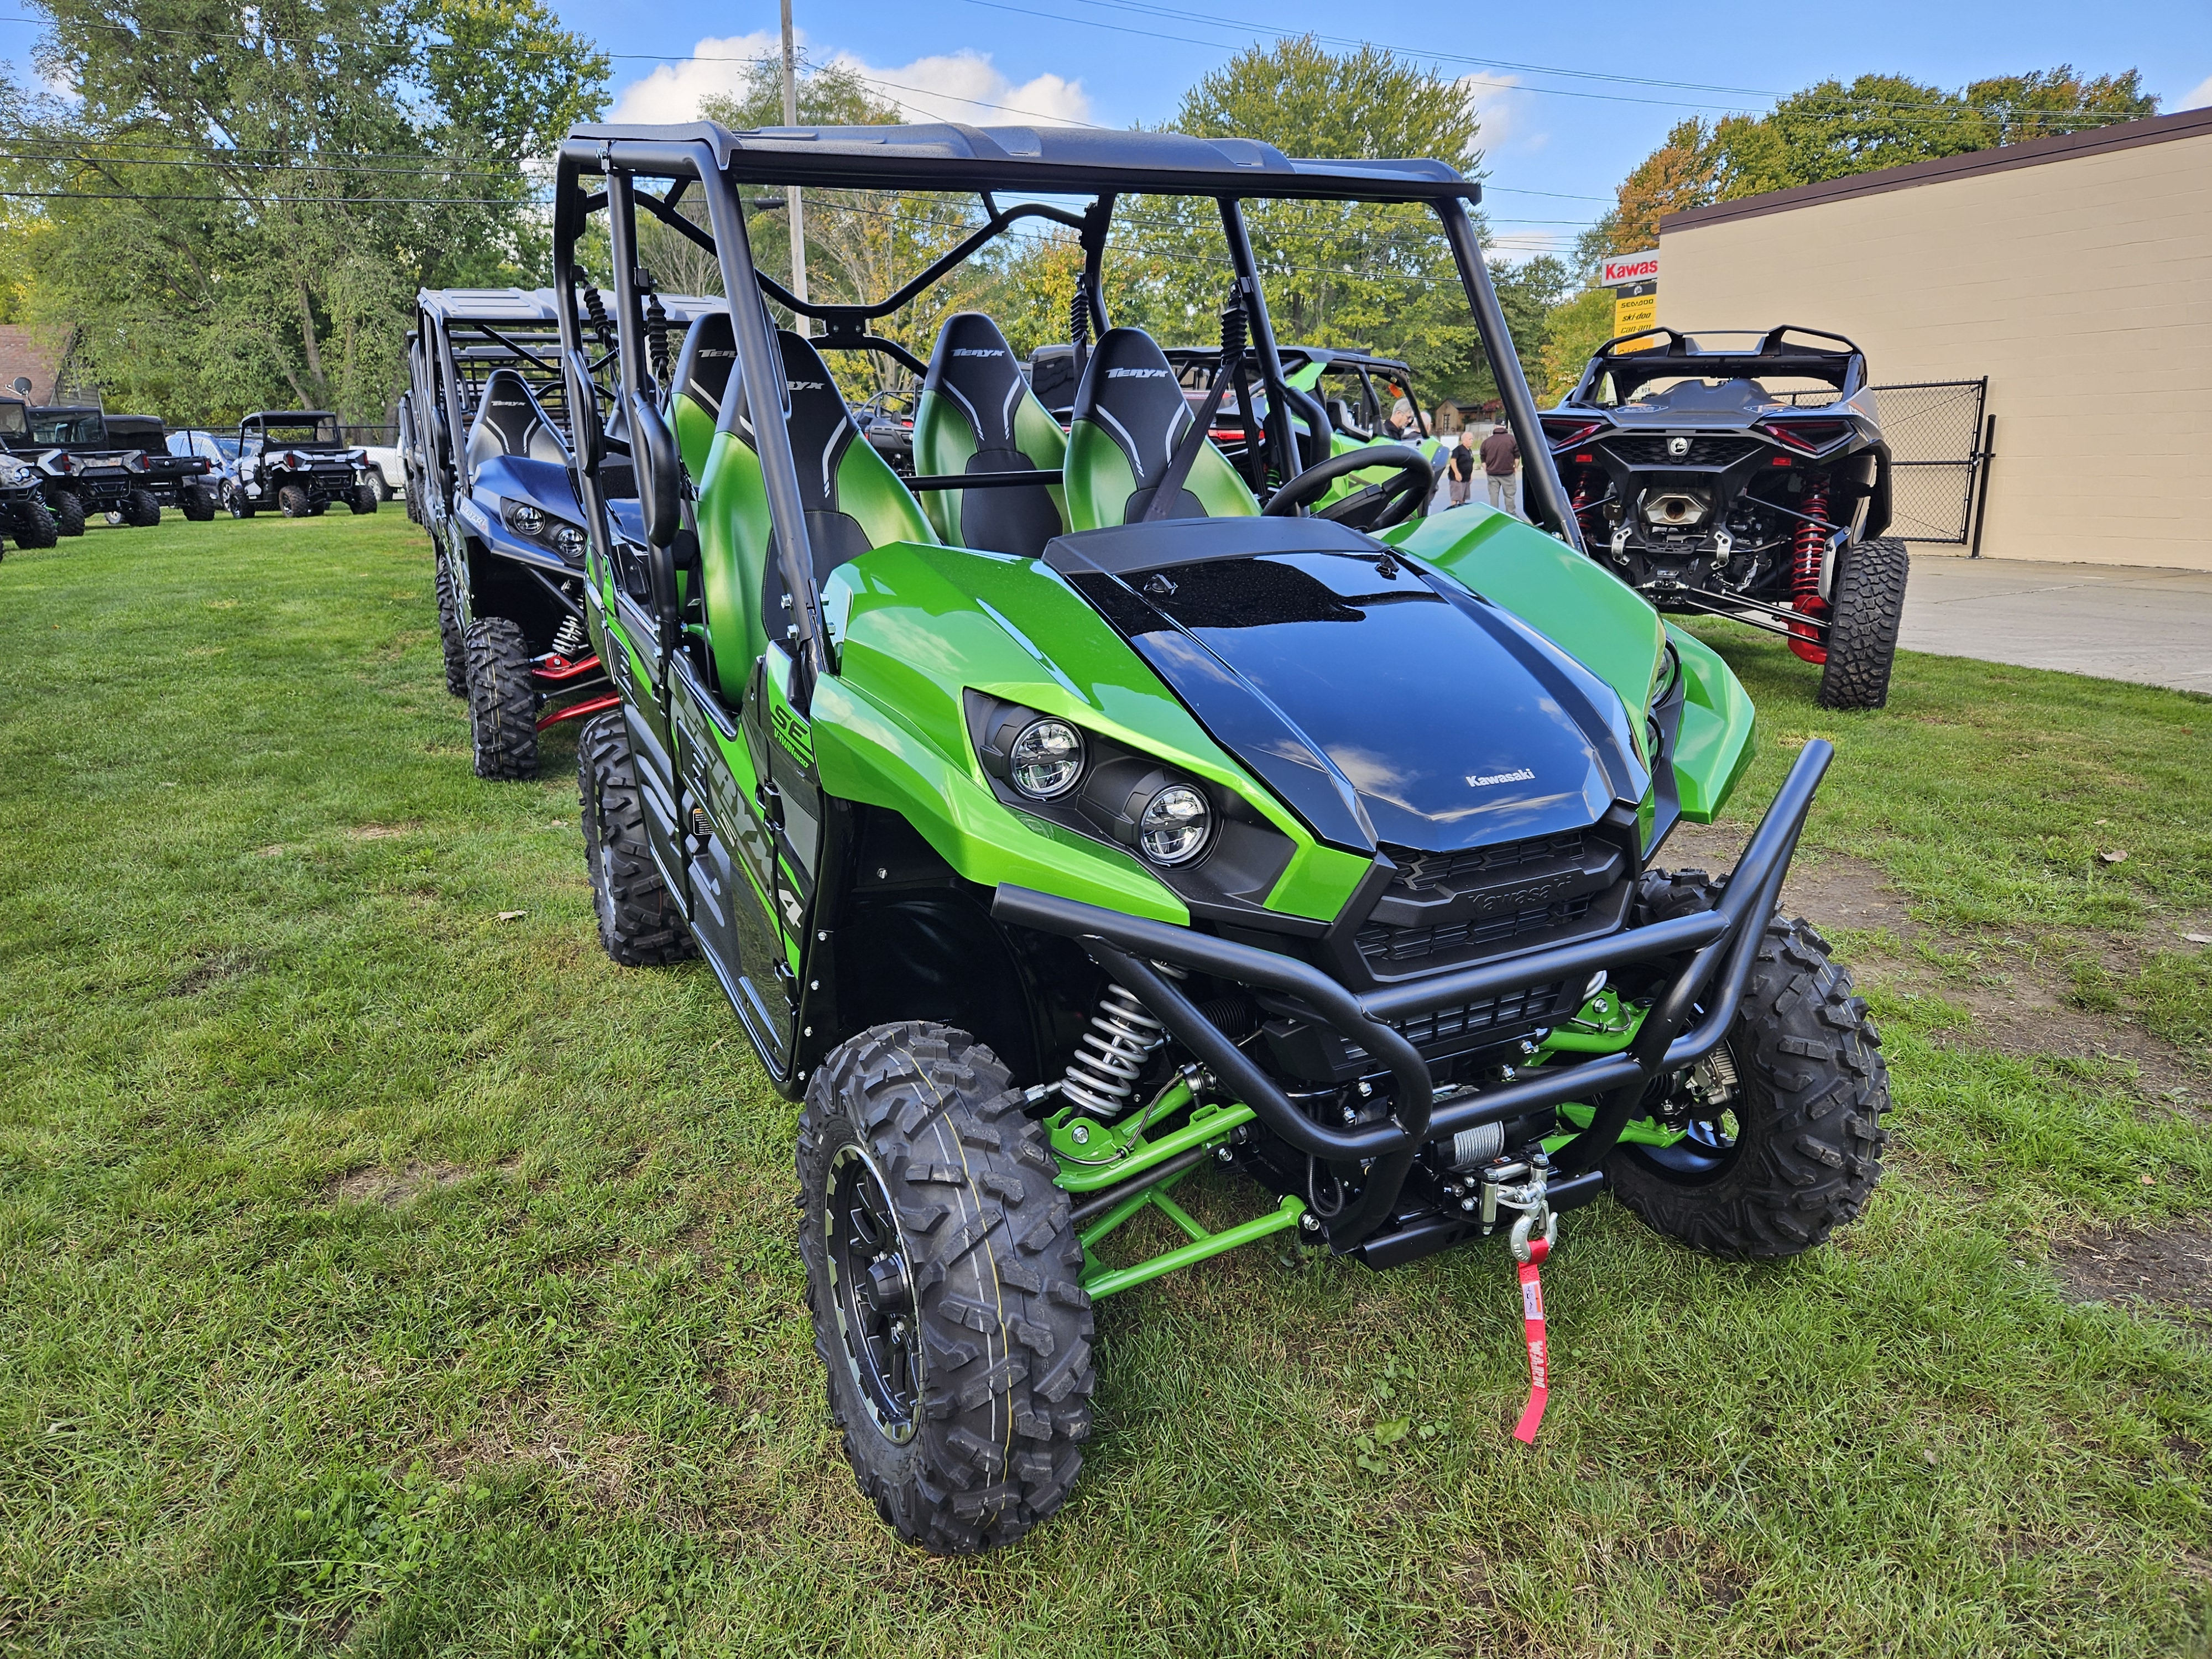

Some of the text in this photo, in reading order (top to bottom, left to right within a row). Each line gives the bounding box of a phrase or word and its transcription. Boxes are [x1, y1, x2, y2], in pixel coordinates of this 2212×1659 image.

[1606, 260, 1658, 280] Kawas
[698, 349, 737, 358] TER
[787, 381, 825, 390] RYX
[775, 704, 808, 739] SE
[1465, 768, 1536, 787] Kawasaki
